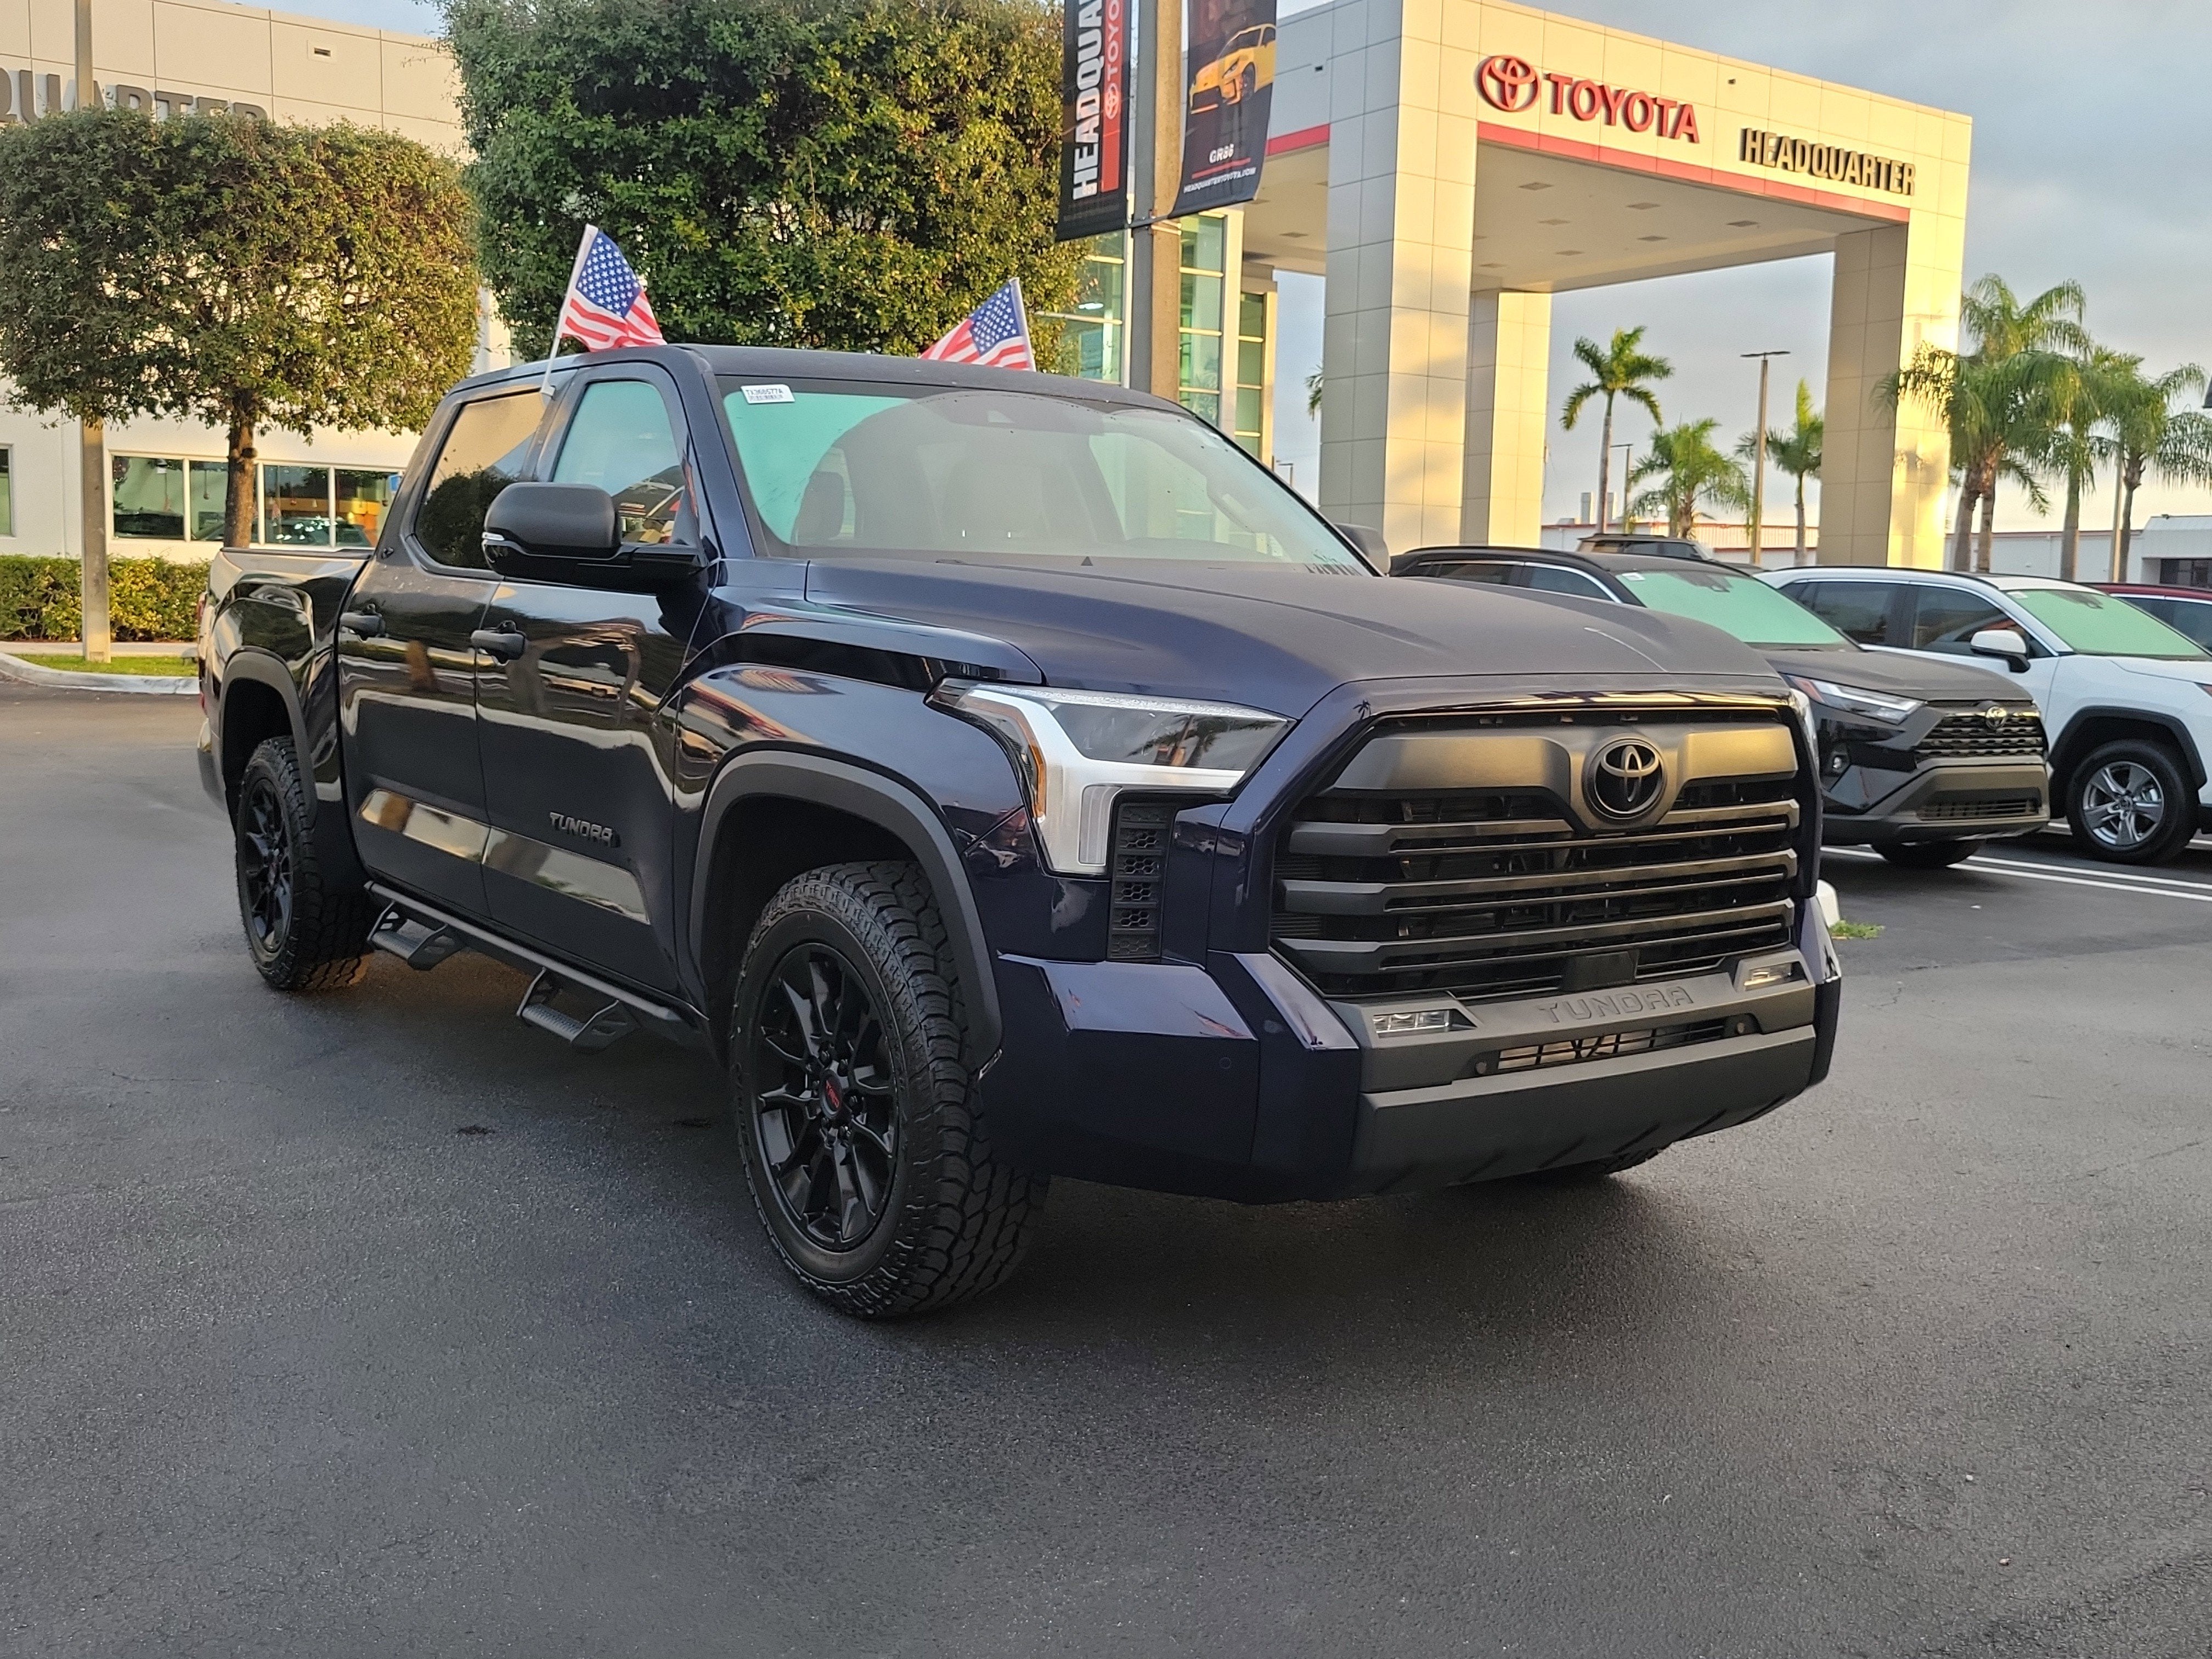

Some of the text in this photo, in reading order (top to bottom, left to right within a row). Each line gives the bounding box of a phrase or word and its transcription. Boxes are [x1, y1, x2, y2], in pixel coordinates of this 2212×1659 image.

[1073, 0, 1104, 200] HEADQUA
[1545, 72, 1700, 144] TOYOTA
[1741, 127, 1916, 196] HEADQUARTER
[550, 812, 613, 848] TUNDRA
[1538, 986, 1694, 1023] TUNDRA
